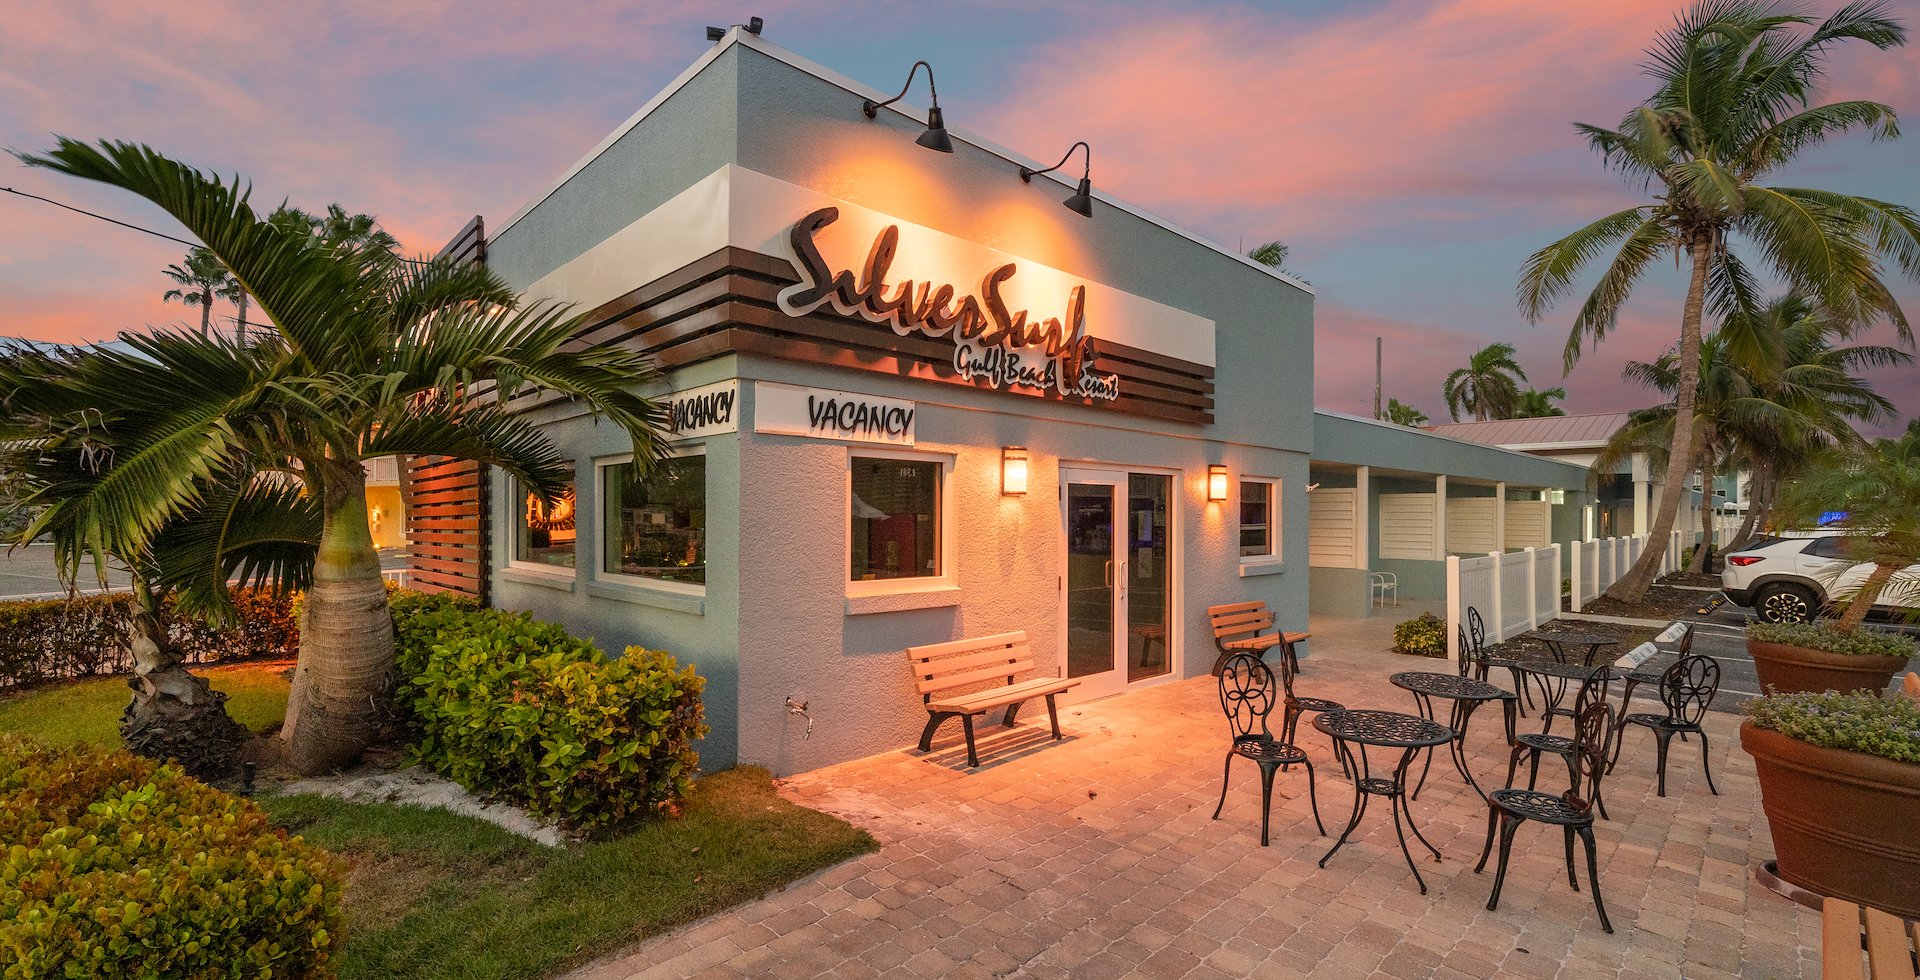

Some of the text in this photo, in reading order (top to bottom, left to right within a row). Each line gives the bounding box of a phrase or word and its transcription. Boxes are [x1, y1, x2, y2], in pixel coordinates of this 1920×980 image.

[957, 344, 1000, 386] Gulf
[1006, 353, 1056, 386] Beach
[808, 395, 914, 436] VACANCY
